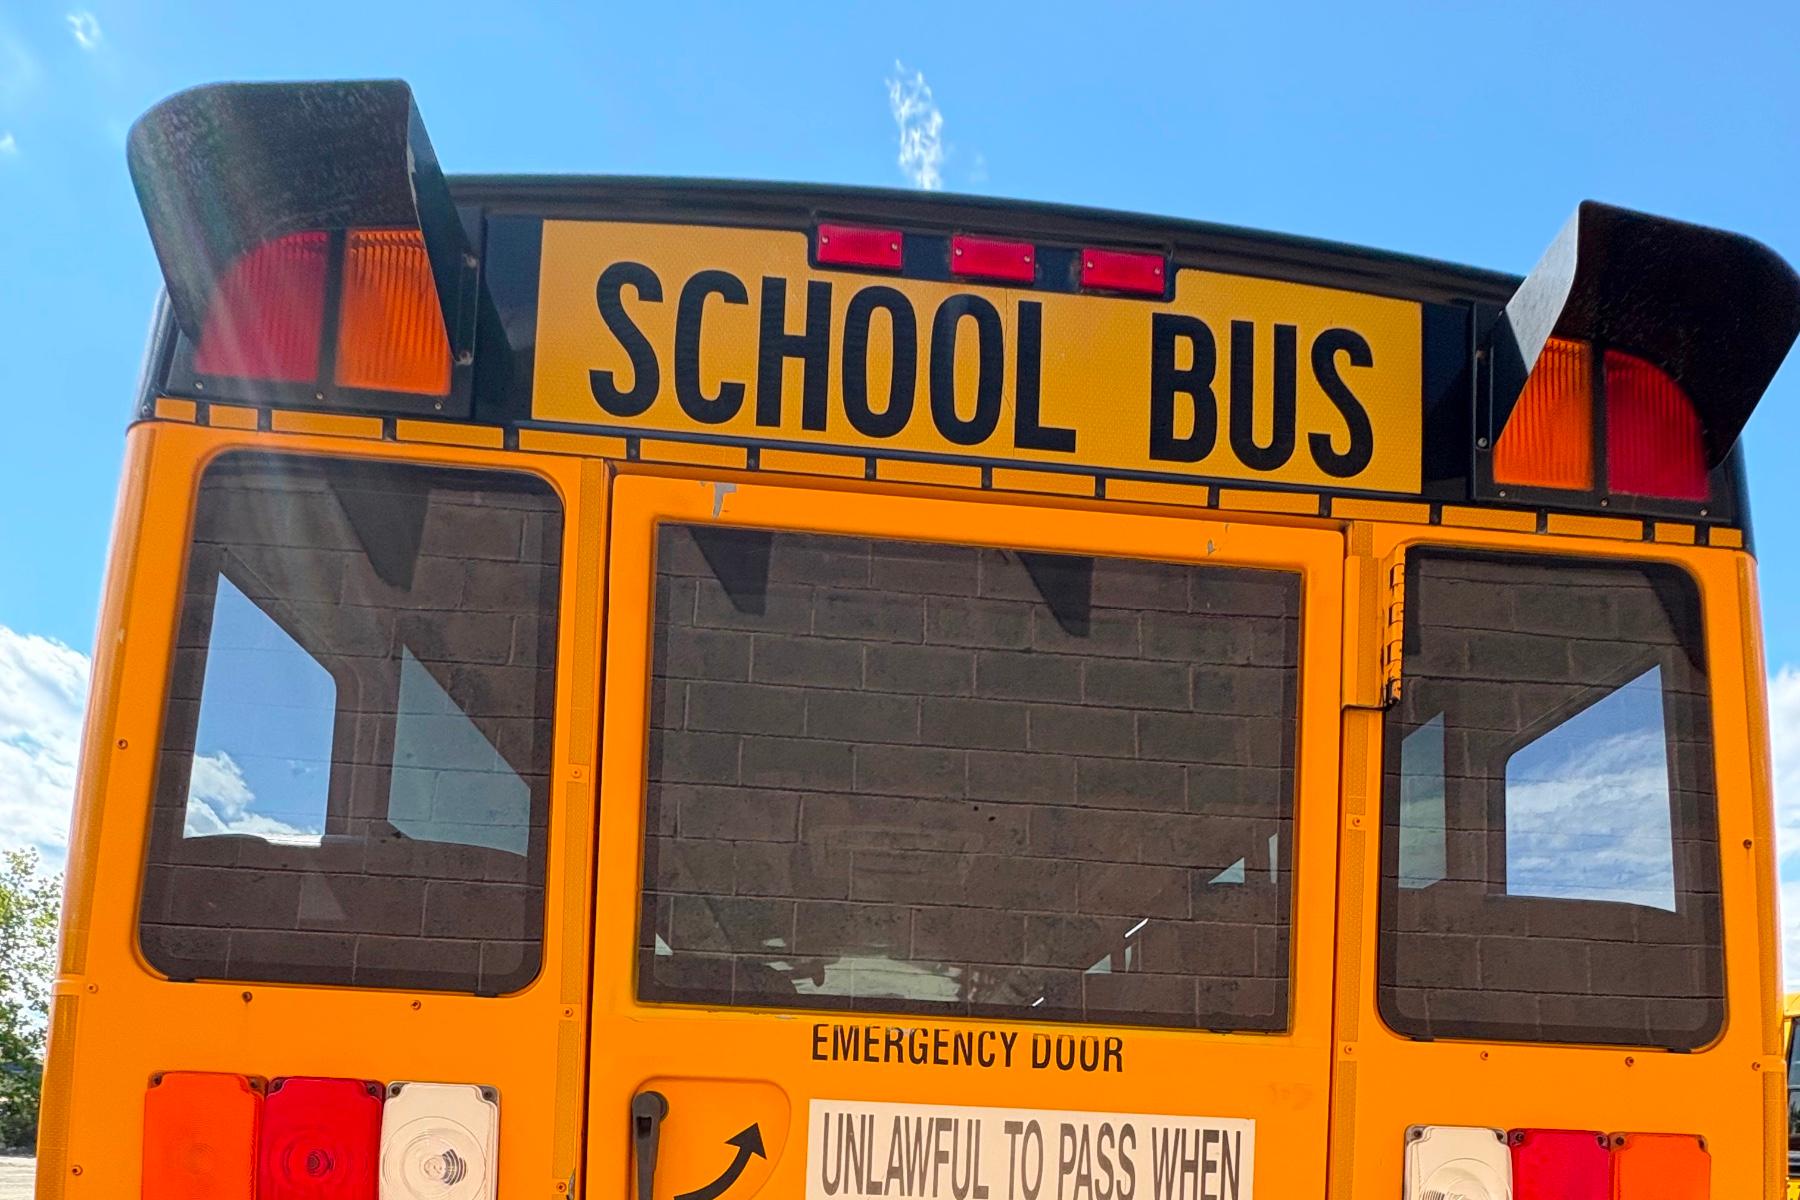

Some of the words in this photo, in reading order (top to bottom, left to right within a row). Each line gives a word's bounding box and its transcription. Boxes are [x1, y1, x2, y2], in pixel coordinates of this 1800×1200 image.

[588, 261, 1077, 453] SCHOOL
[1149, 311, 1375, 479] BUS
[811, 1023, 1018, 1068] EMERGENCY
[1031, 1033, 1124, 1073] DOOR
[821, 1112, 989, 1200] UNLAWFUL
